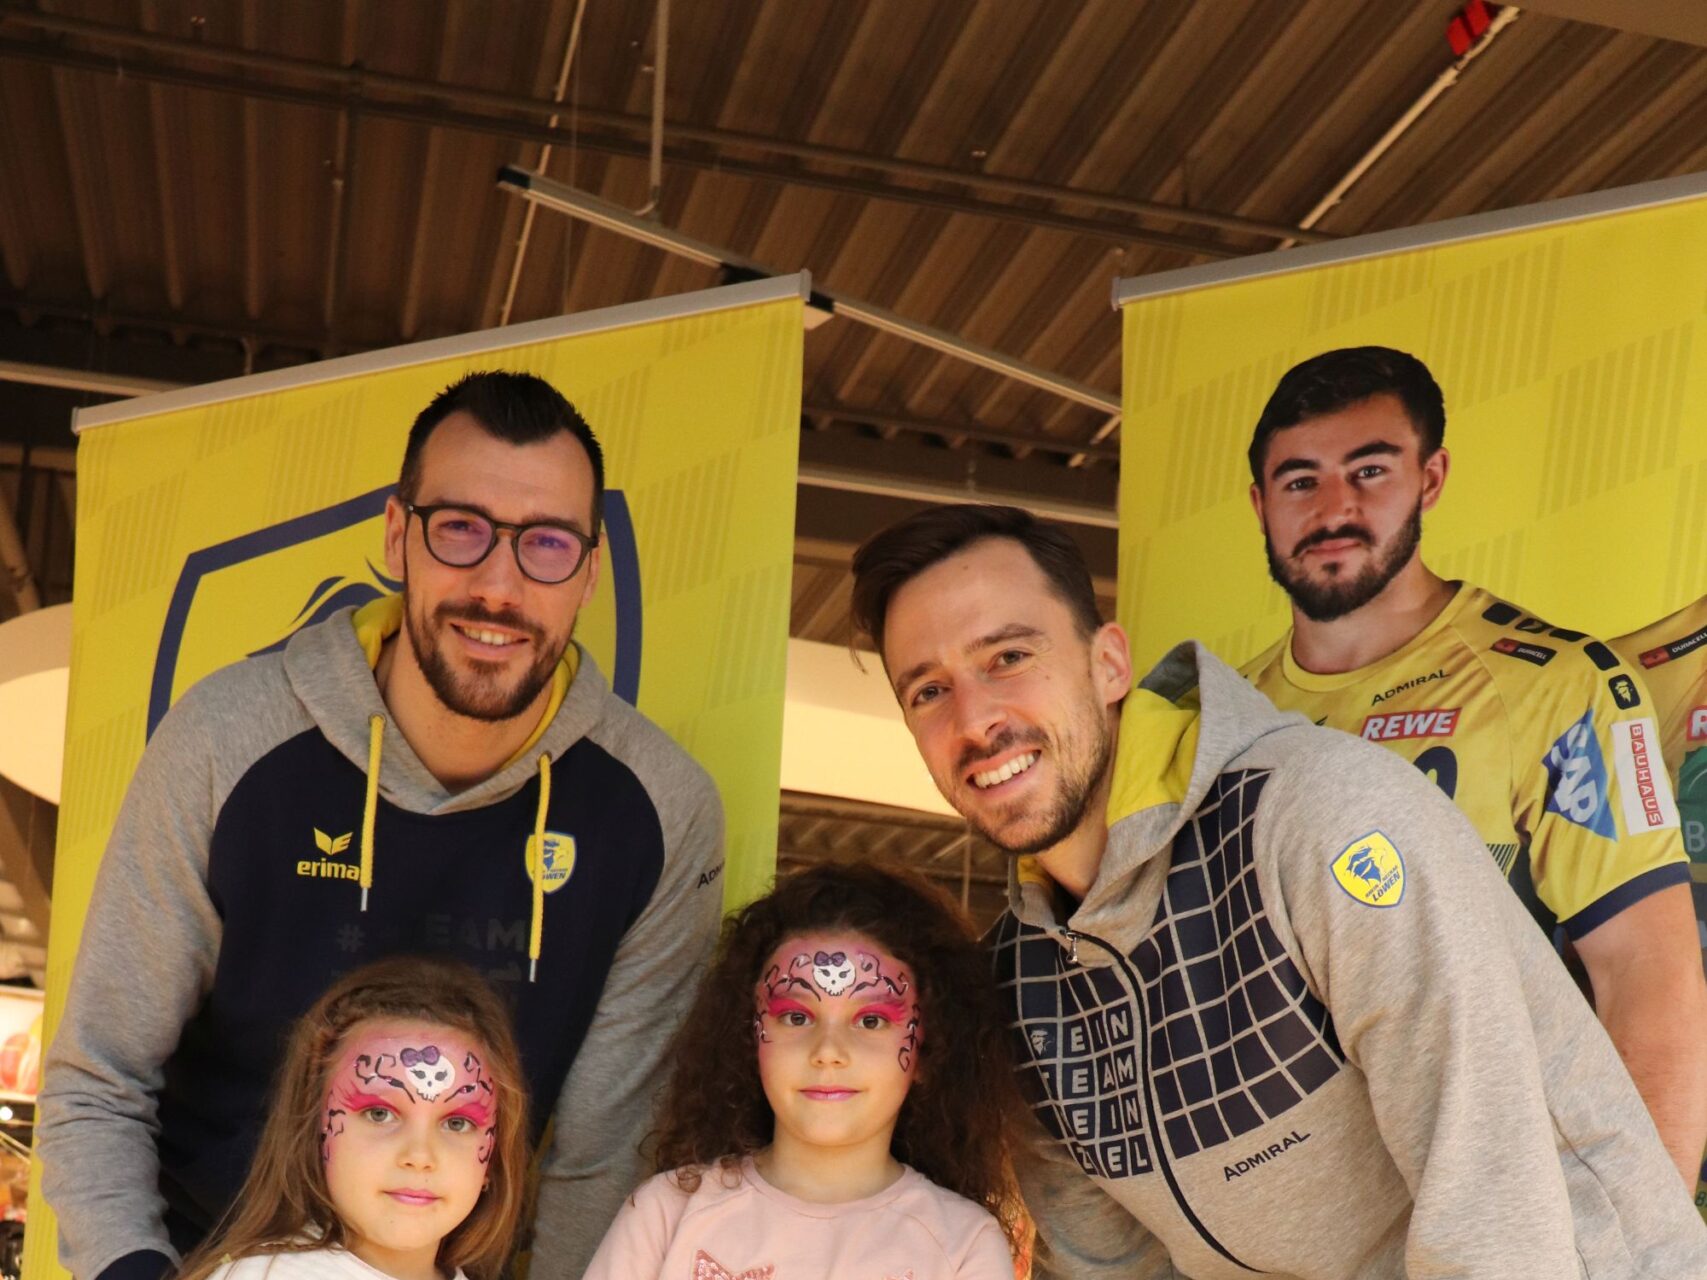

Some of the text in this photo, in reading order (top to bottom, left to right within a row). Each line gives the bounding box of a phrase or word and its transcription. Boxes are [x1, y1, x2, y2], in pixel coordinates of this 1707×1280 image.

[1371, 669, 1450, 706] ADMIRAL
[1362, 710, 1456, 740] REWE
[1551, 723, 1599, 823] SAP
[1630, 724, 1663, 826] BAUHAUS
[296, 857, 361, 881] erima
[1071, 1010, 1129, 1052] EIN
[1072, 1097, 1139, 1135] EIN
[1223, 1130, 1312, 1182] ADMIRAL
